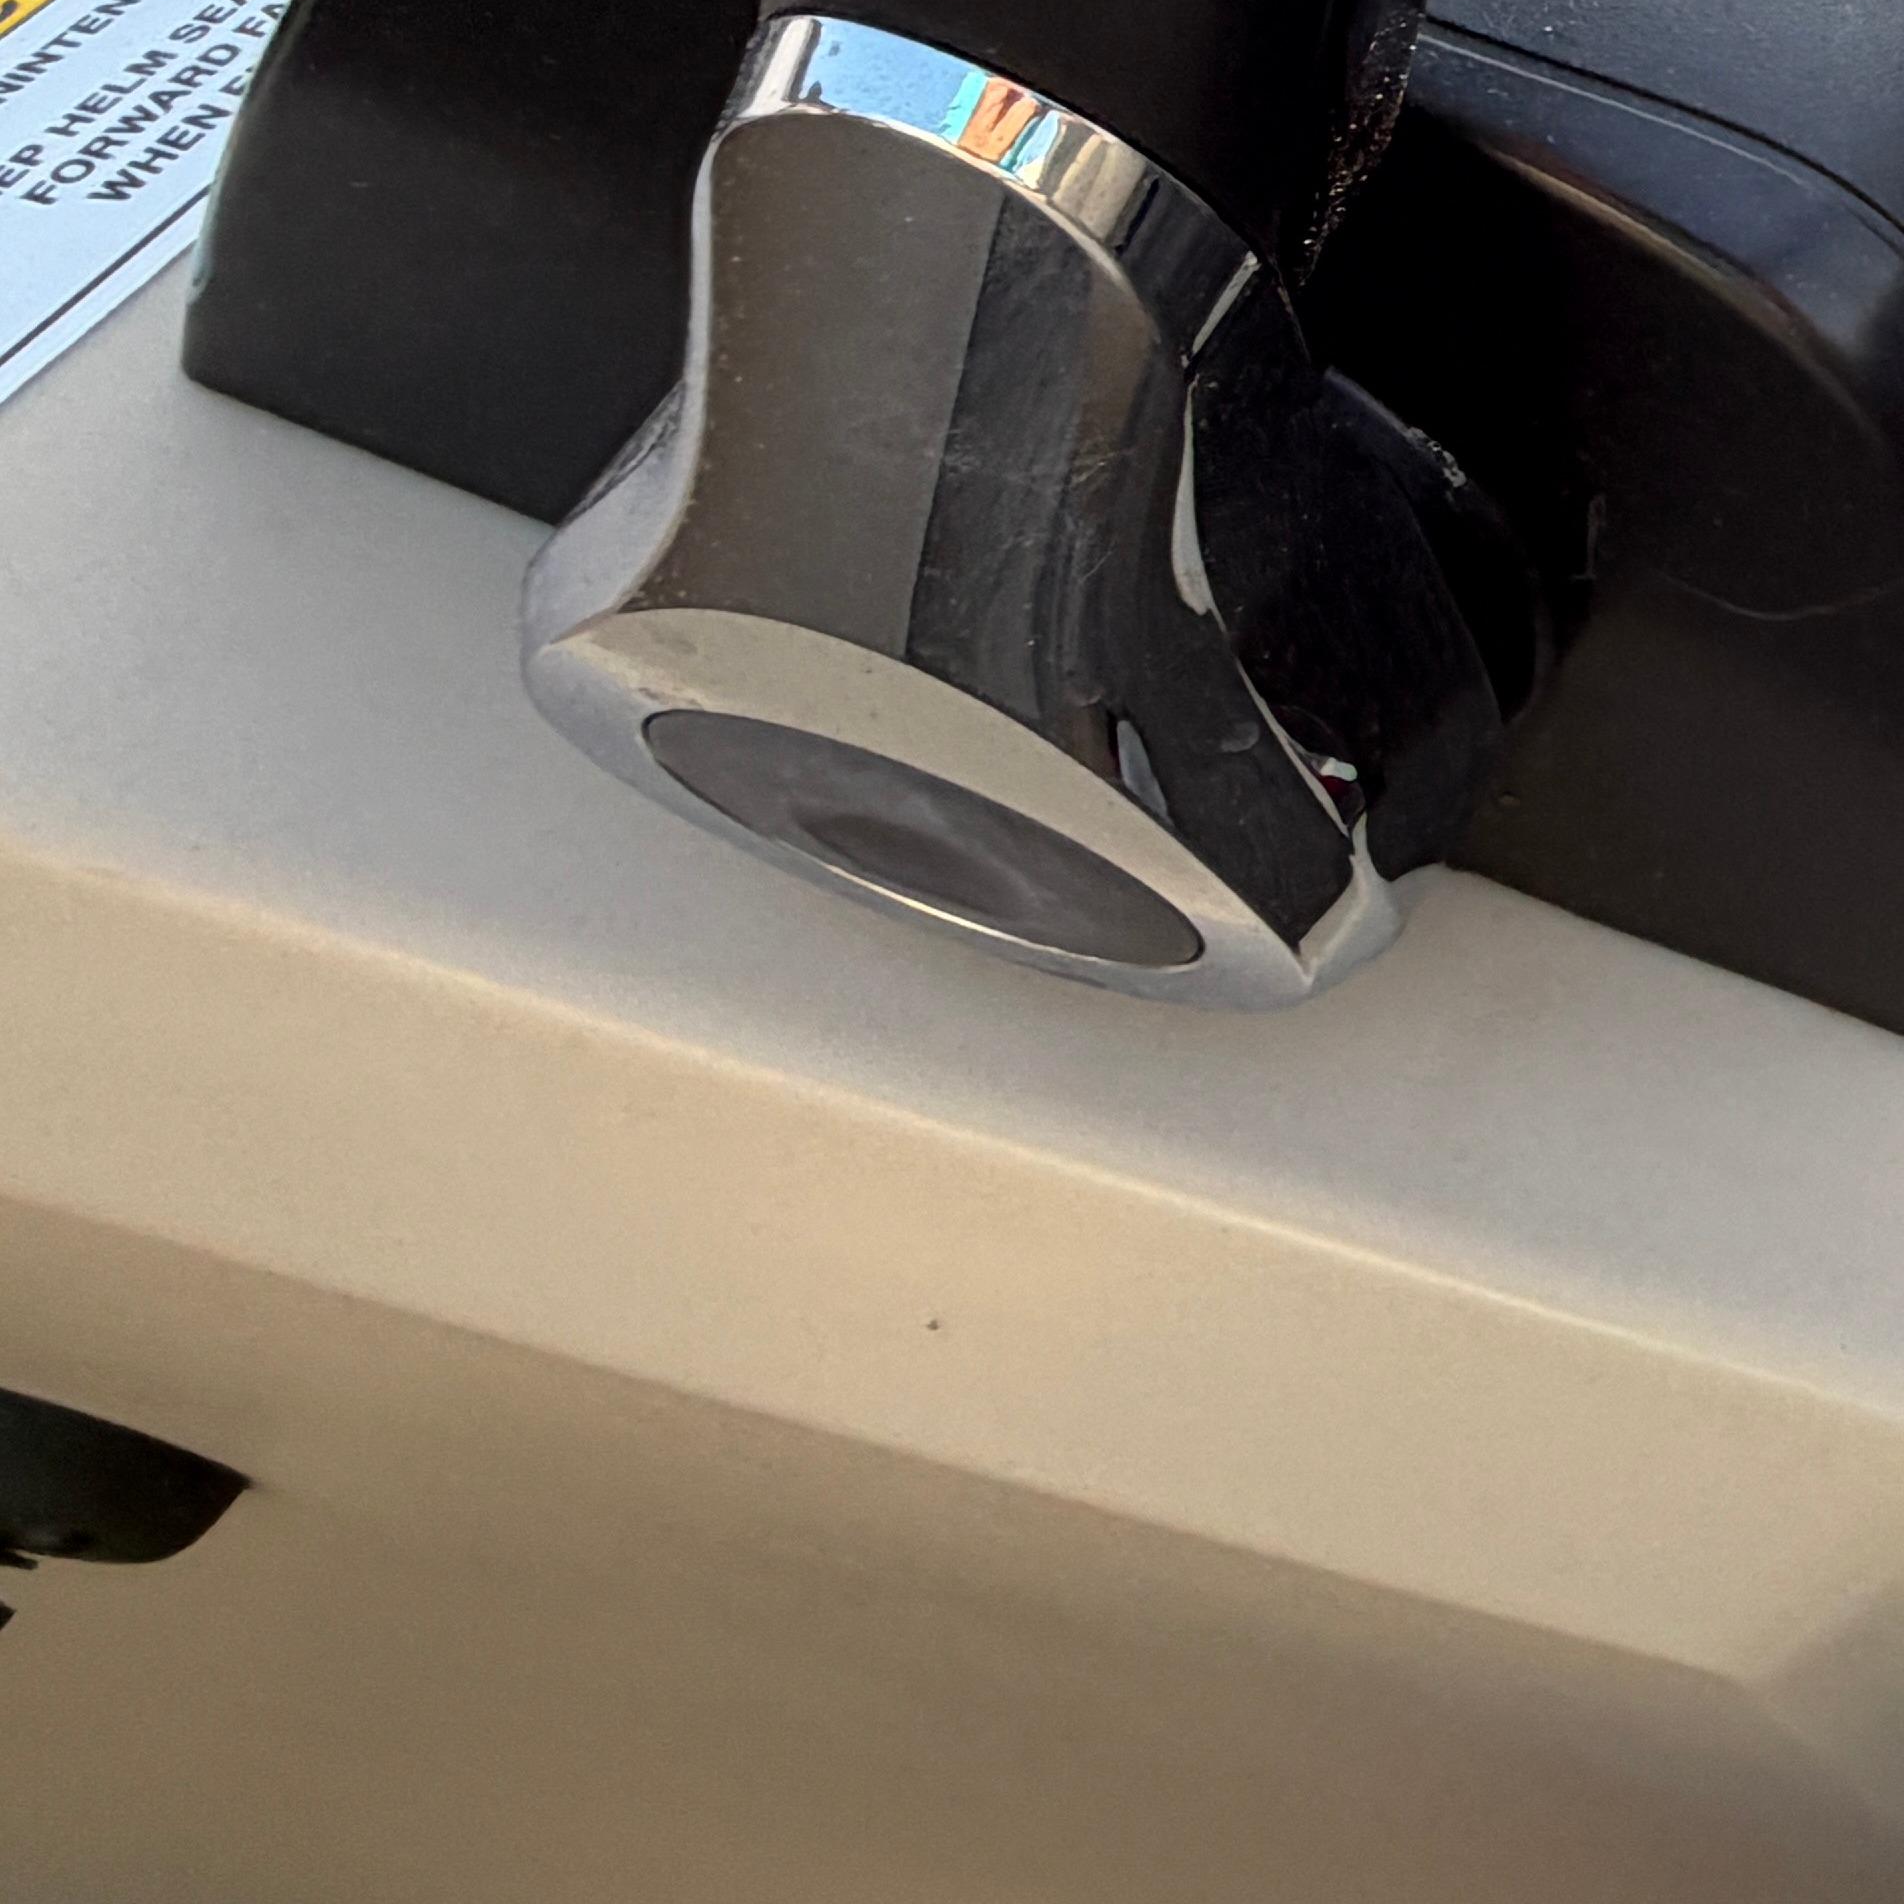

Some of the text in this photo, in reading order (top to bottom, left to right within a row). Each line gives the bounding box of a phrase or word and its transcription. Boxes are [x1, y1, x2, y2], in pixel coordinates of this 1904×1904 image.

[20, 42, 241, 205] FORWARD
[45, 50, 174, 137] HELM
[86, 104, 235, 202] WHEN
